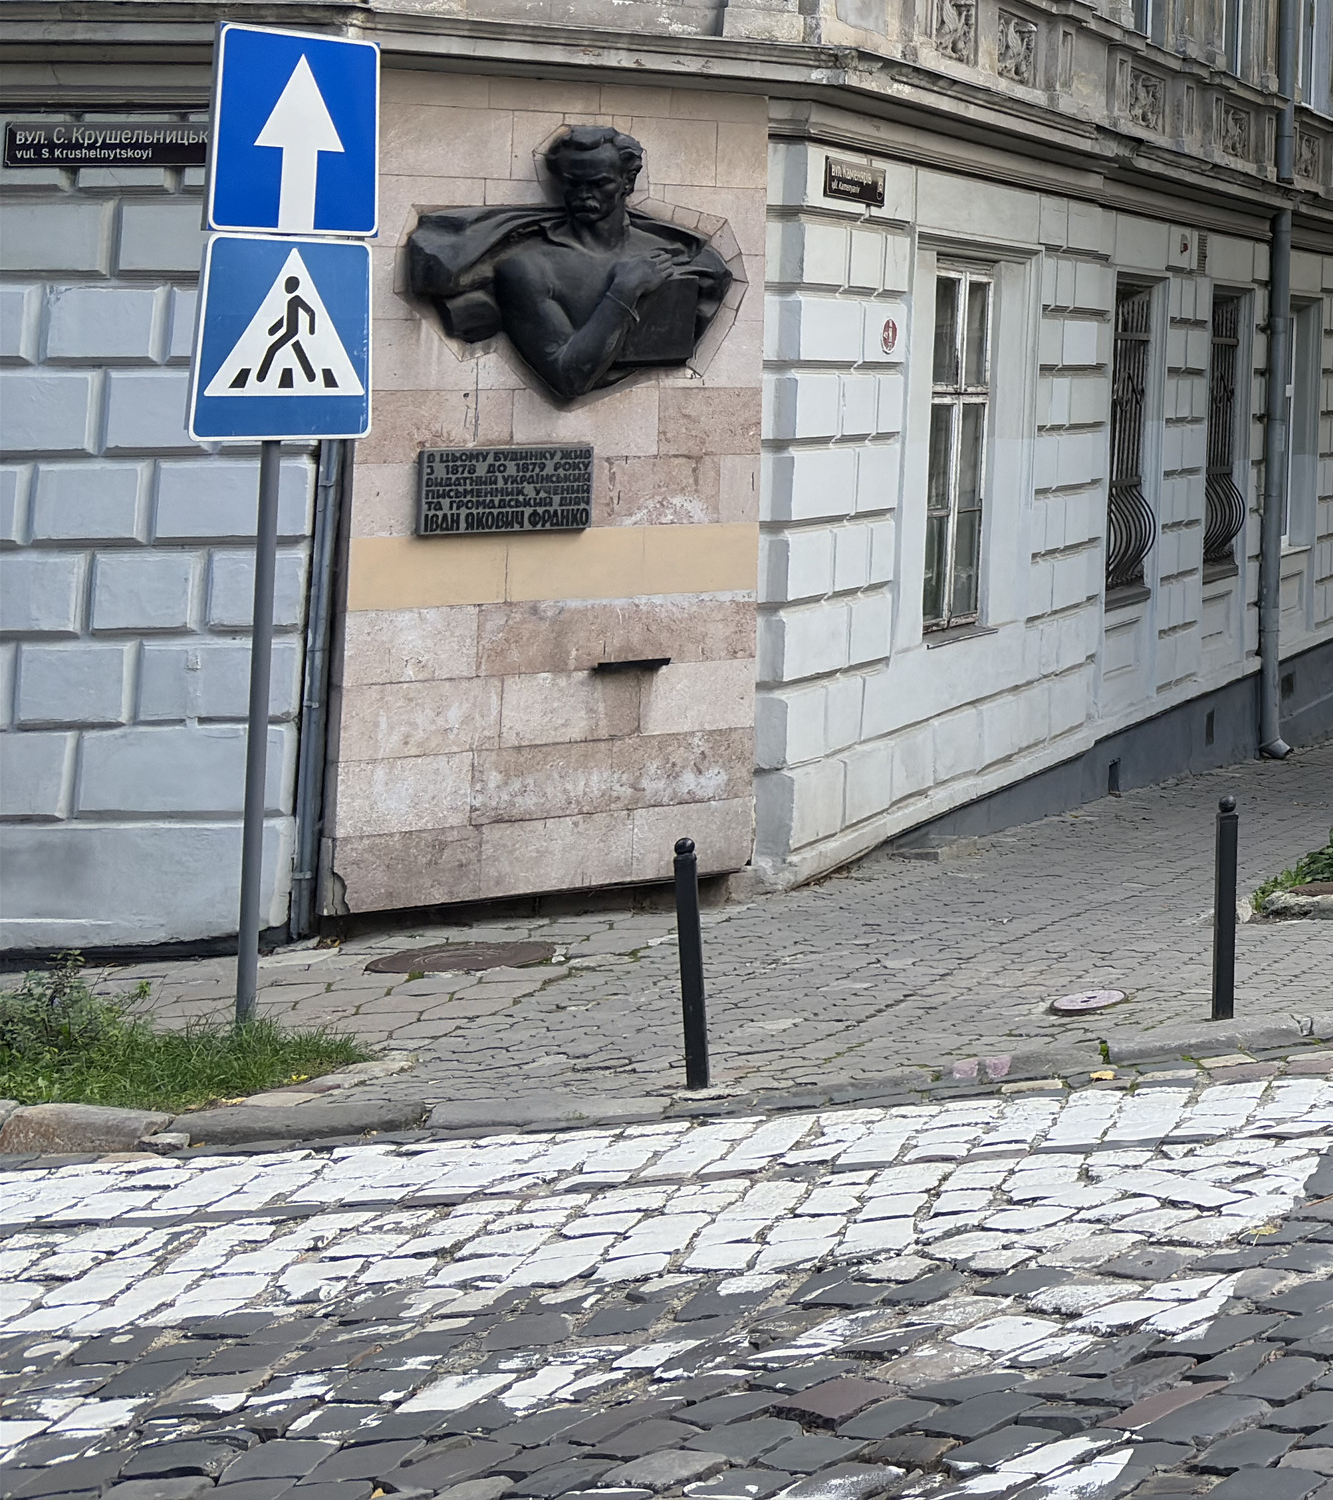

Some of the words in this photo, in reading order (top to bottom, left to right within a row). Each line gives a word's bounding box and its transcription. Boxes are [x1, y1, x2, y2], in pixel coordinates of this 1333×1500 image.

[15, 130, 48, 145] вул.
[53, 127, 68, 144] С.
[72, 127, 209, 146] Крушельницьк
[15, 148, 38, 159] vul.
[41, 148, 52, 159] S.
[54, 148, 153, 160] Krushelnytskoyi
[426, 453, 436, 464] В
[439, 451, 489, 464] ЦЬОМУ
[493, 450, 556, 463] БУДИНКУ
[559, 449, 592, 461] ЖИВ
[425, 464, 435, 476] З
[444, 464, 477, 476] 1878
[486, 463, 508, 475] ДО
[514, 462, 547, 474] 1879
[553, 461, 592, 473] РОКУ
[425, 474, 499, 487] ВИДАТНИЙ
[502, 471, 591, 485] УКРАЇНСЬКИЙ
[533, 484, 591, 497] УЧЕНИЙ
[425, 501, 443, 512] ТА
[449, 497, 553, 511] ГРОМАДСЬКИЙ
[558, 495, 591, 508] ДІЯЧ
[423, 512, 461, 533] ІВАН
[465, 510, 525, 532] ЯКОВИЧ
[528, 507, 589, 529] ФРАНКО
